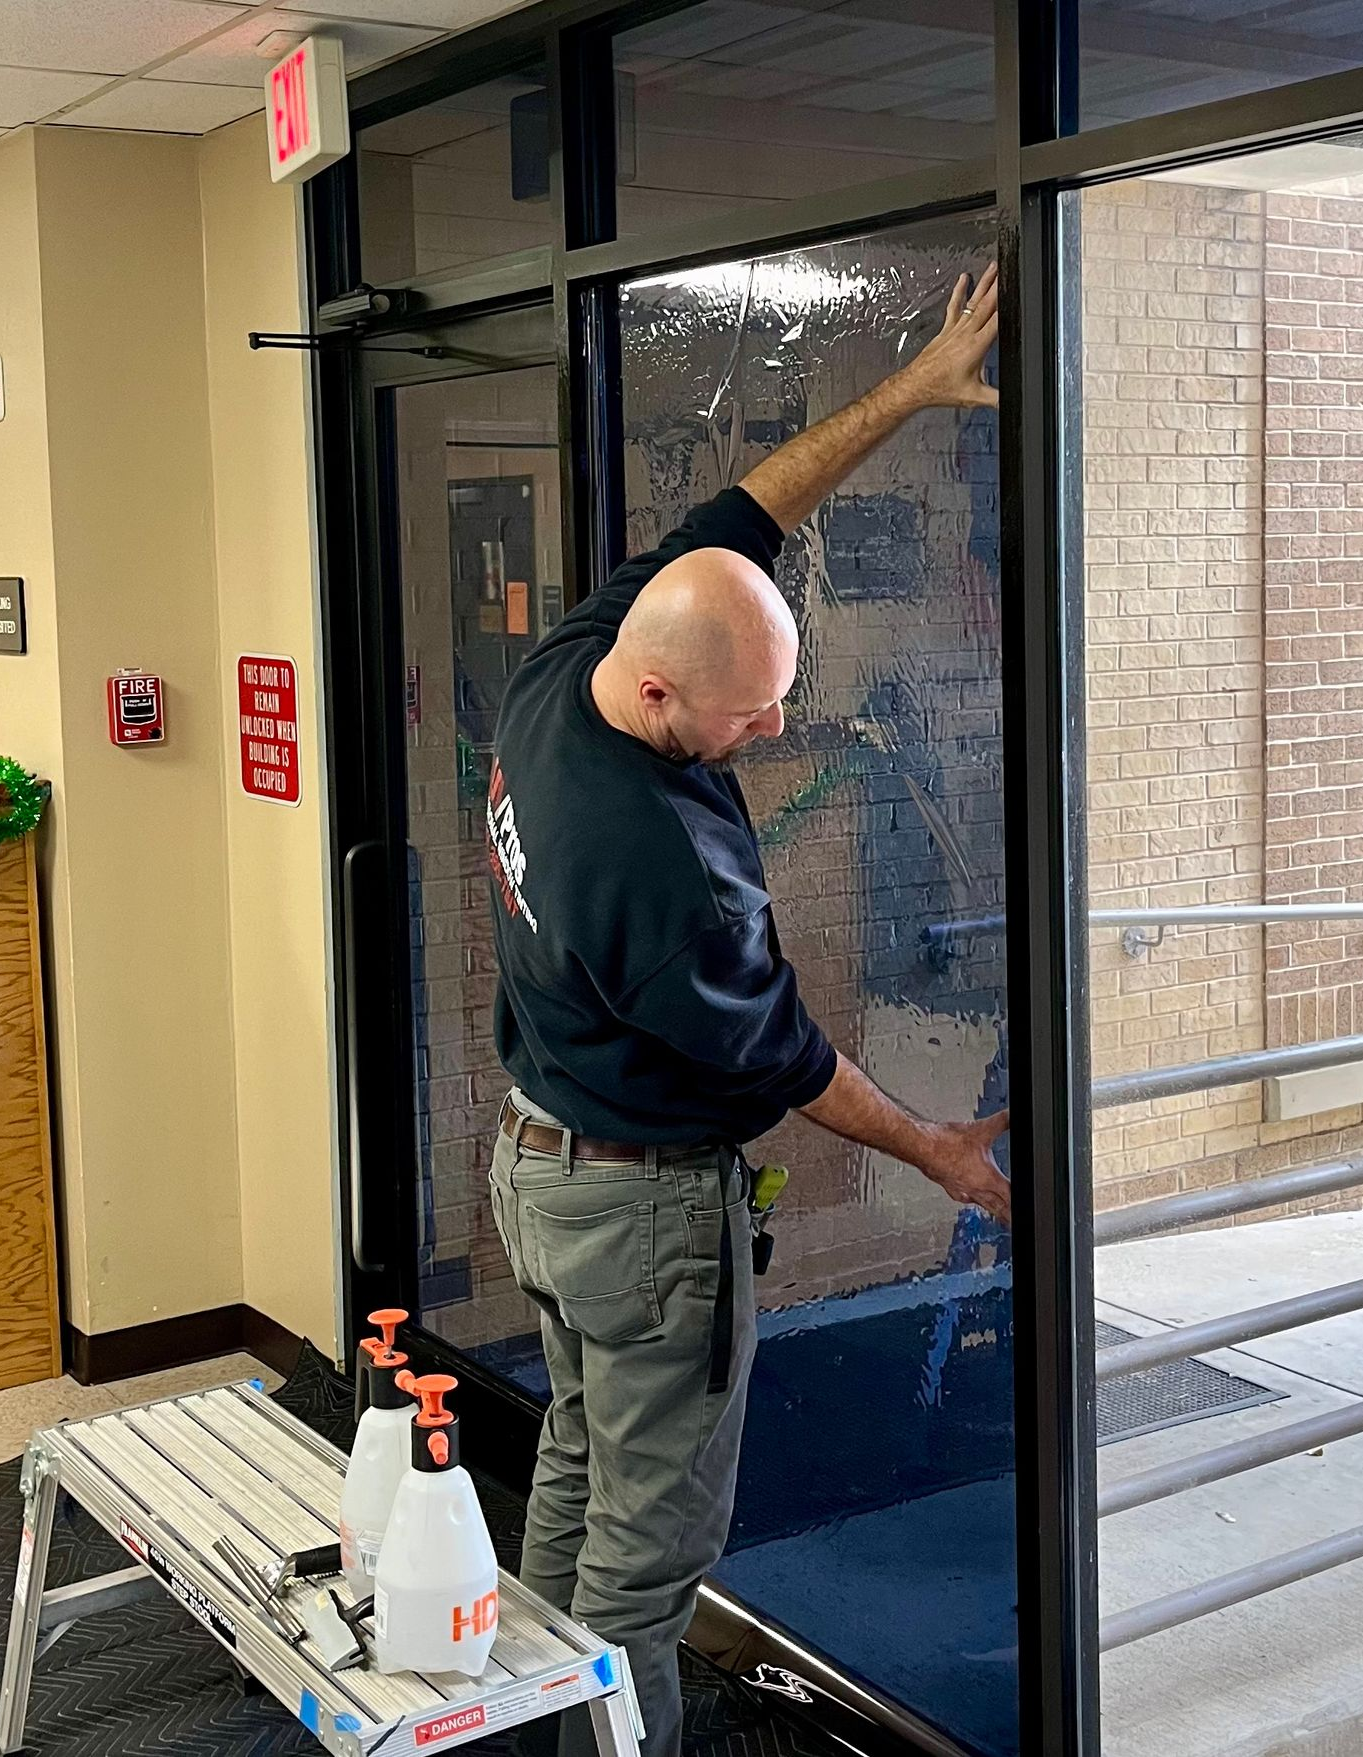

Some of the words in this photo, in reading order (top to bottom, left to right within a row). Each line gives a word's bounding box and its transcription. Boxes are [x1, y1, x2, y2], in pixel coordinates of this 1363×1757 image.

[271, 49, 310, 163] EXIT
[118, 679, 156, 695] FIRE
[243, 664, 258, 685] THIS
[260, 665, 279, 687] DOOR
[281, 668, 290, 688] TO
[254, 691, 280, 713] REMAIN
[241, 714, 275, 738] UNLOCKED
[277, 720, 297, 742] WHEN
[248, 741, 280, 765] BUILDING
[281, 746, 290, 767] IS
[253, 767, 287, 793] OCCUPIED
[165, 1559, 197, 1598] WORKING
[198, 1588, 236, 1635] PLATFORM
[171, 1577, 189, 1599] STEP
[190, 1595, 213, 1626] STOOL
[431, 1710, 482, 1736] DANGER
